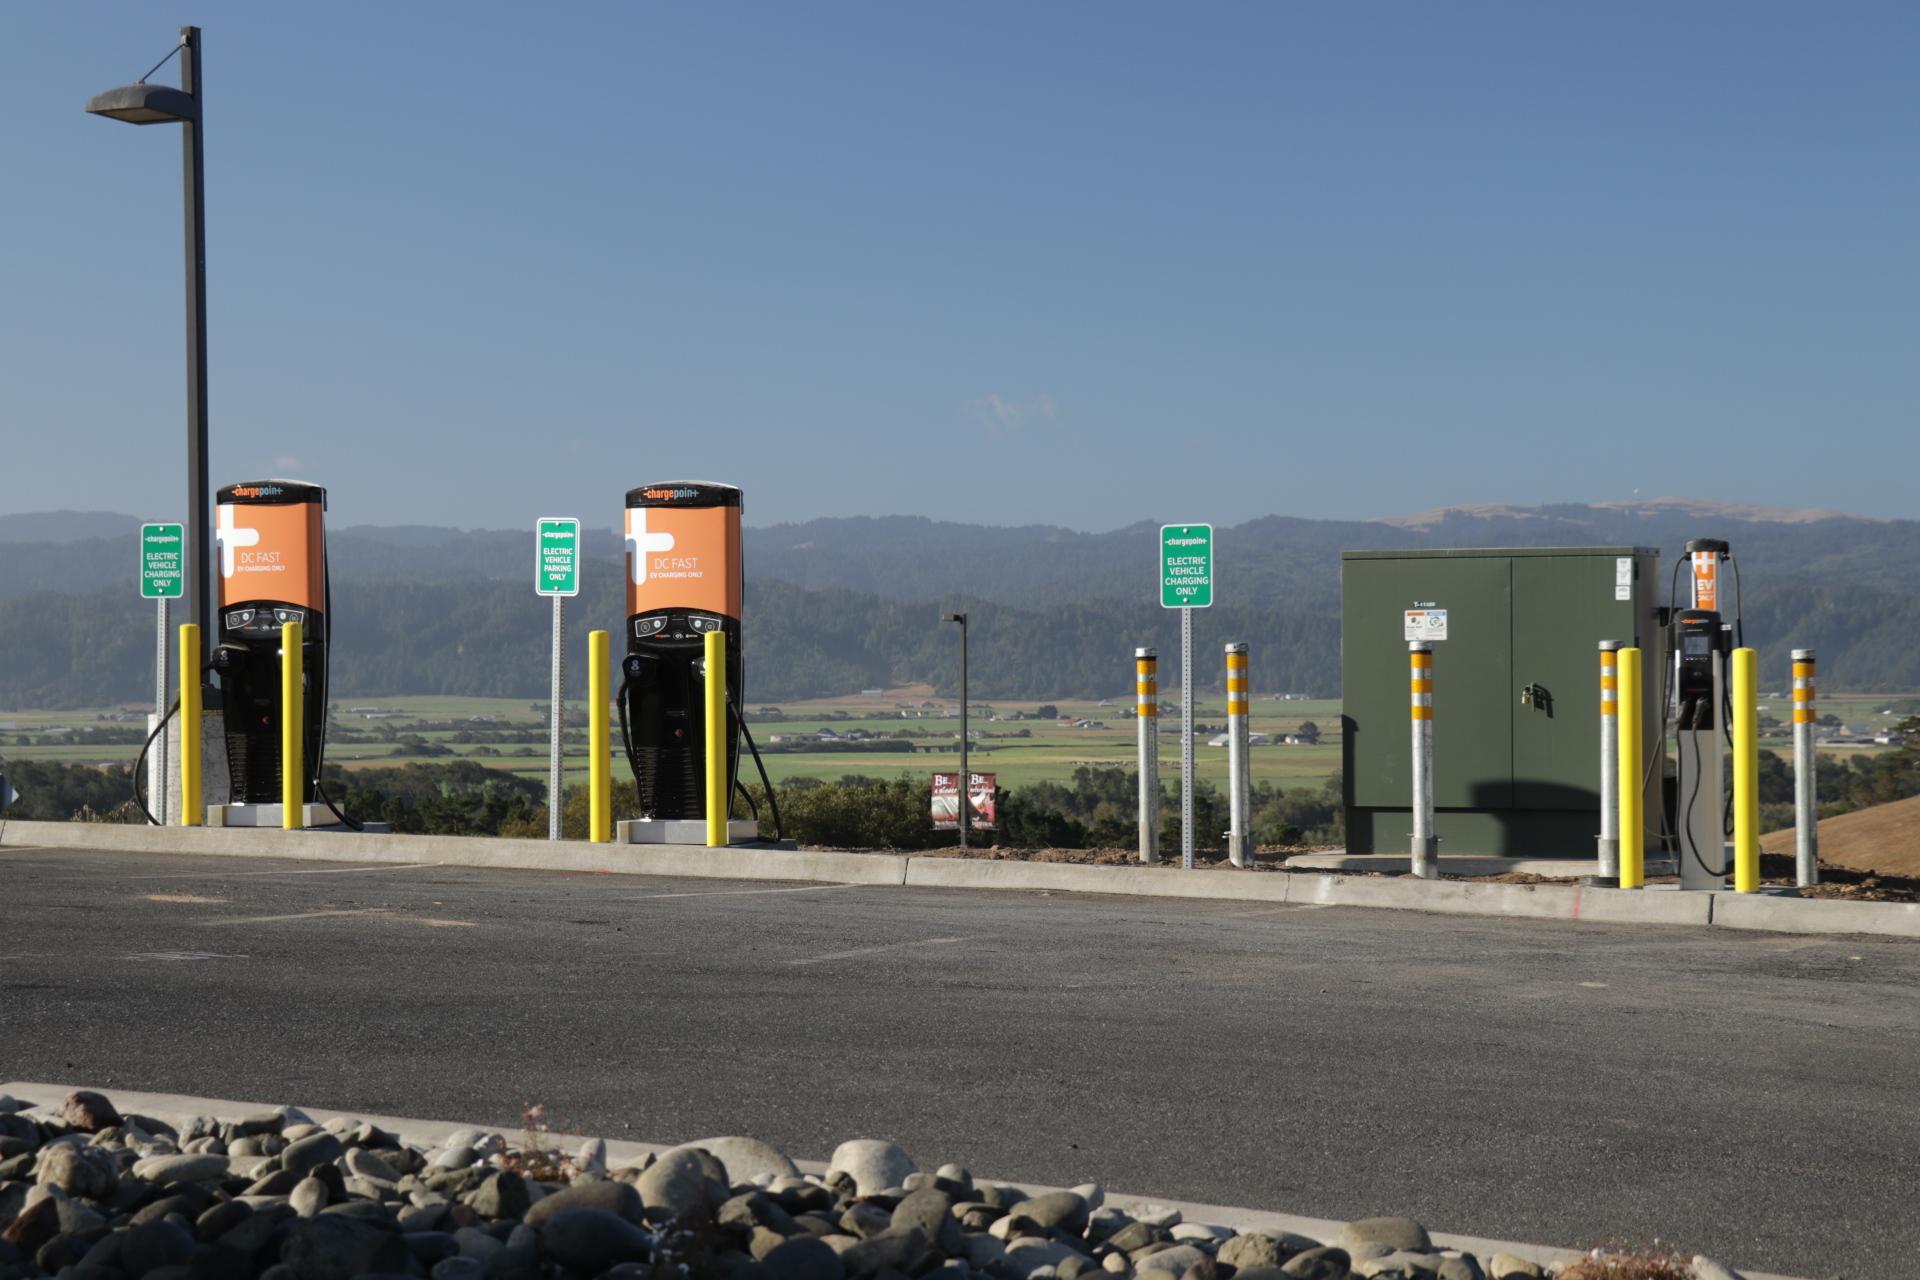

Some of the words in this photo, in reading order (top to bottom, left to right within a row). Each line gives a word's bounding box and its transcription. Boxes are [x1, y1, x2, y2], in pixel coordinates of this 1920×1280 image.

[241, 552, 254, 563] DC
[256, 552, 281, 563] FAST
[1167, 557, 1206, 566] ELECTRIC
[654, 558, 670, 570] DC
[672, 558, 698, 569] FAST
[1169, 567, 1204, 575] VEHICLE
[1165, 576, 1208, 585] CHARGING
[1697, 579, 1713, 591] EV
[1176, 587, 1198, 595] ONLY
